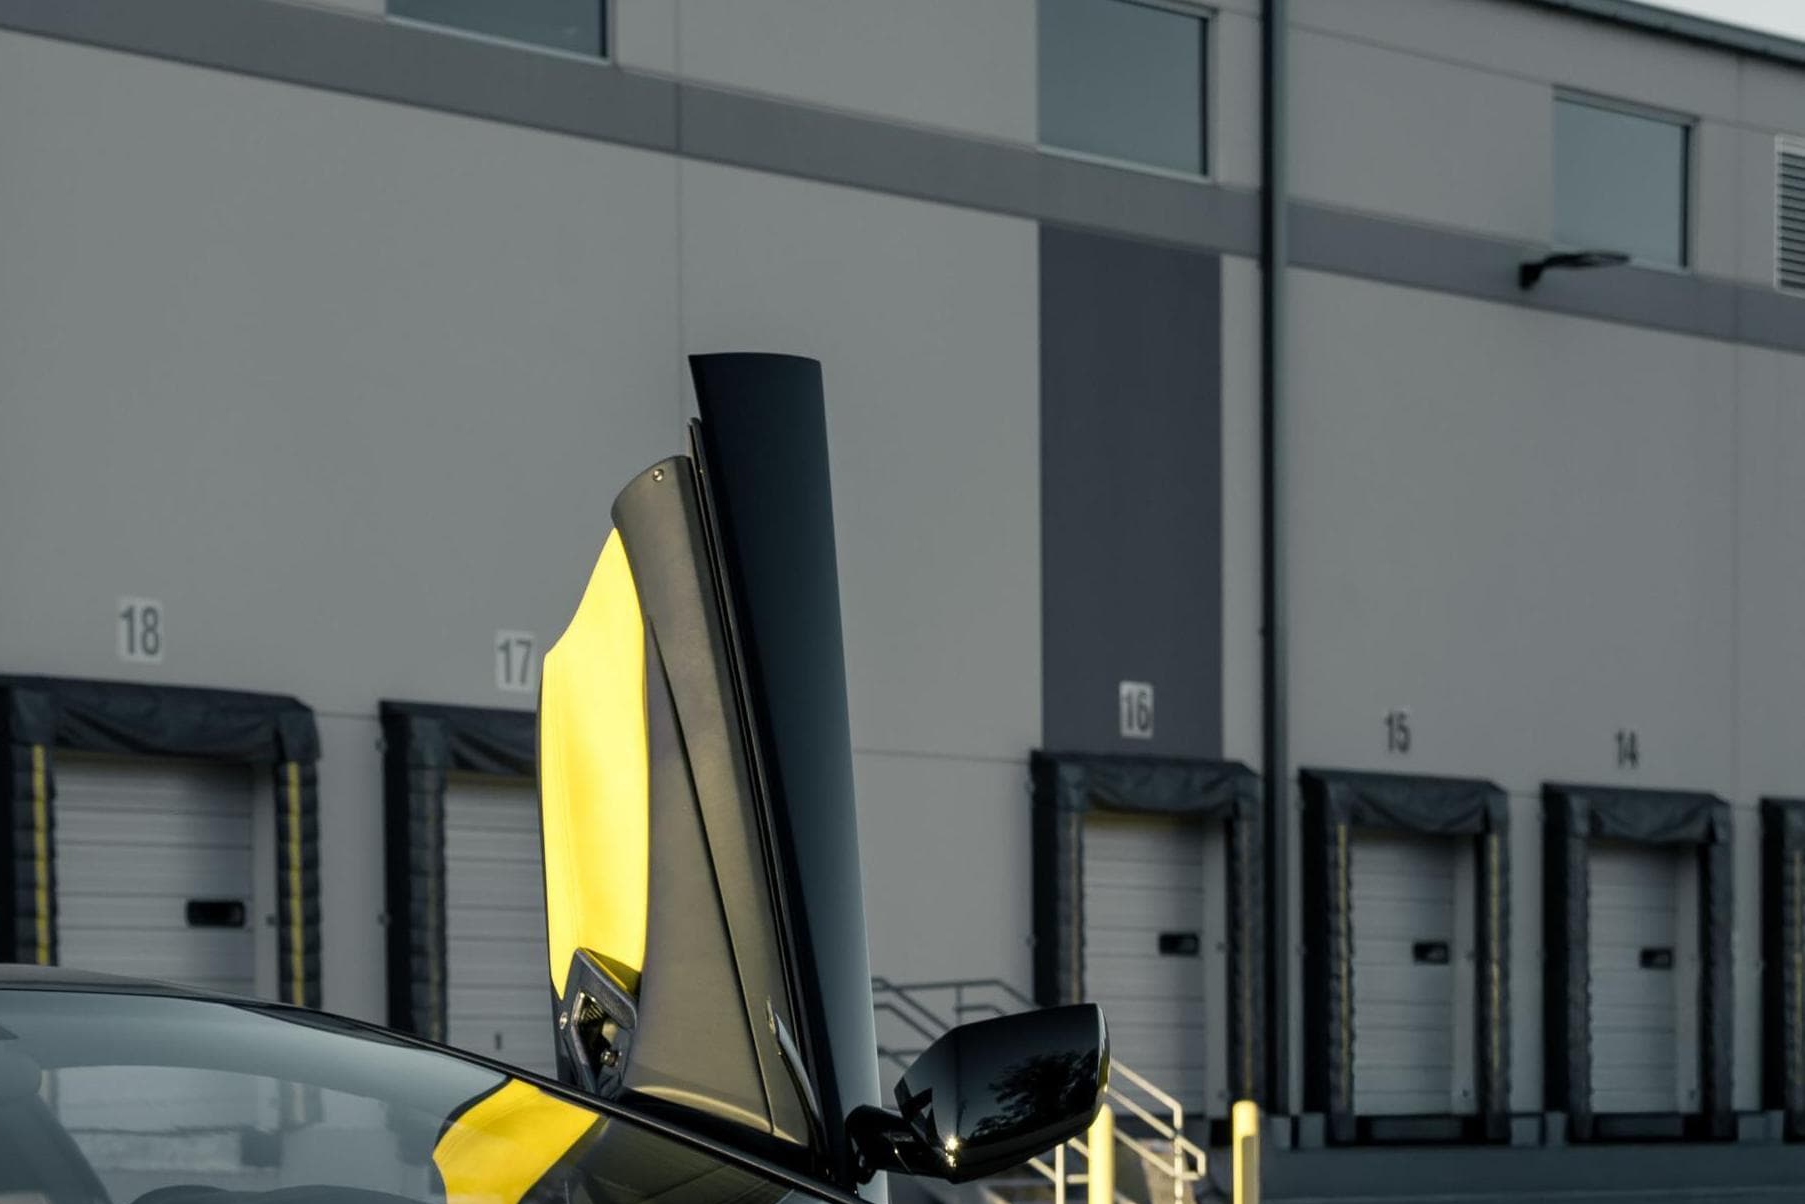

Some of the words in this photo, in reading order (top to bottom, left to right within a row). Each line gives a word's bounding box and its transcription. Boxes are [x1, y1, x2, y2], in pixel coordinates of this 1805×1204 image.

[120, 605, 161, 656] 18
[496, 638, 533, 687] 17
[1121, 690, 1151, 733] 16
[1385, 711, 1411, 754] 15
[1614, 730, 1640, 768] 14
